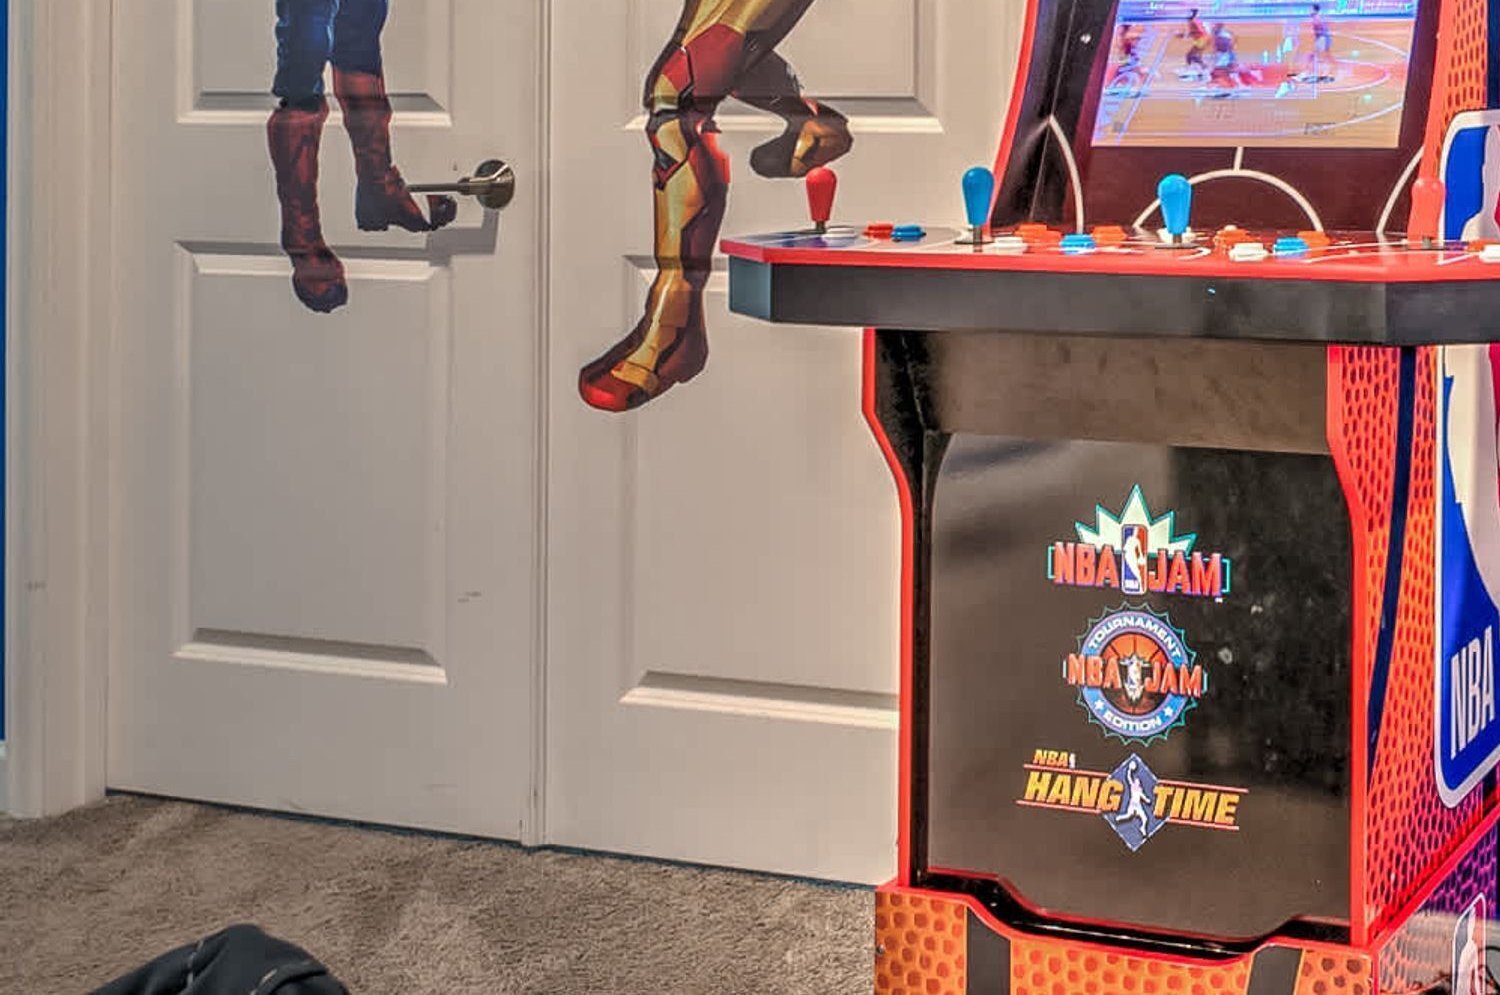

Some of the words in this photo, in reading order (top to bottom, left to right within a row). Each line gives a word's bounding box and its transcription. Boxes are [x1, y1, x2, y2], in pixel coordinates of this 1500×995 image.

[1052, 541, 1120, 589] NBA
[1148, 548, 1223, 597] JAM
[1087, 615, 1182, 659] TOURNAMENT
[1066, 653, 1121, 689] NBA
[1145, 660, 1203, 698] JAM
[1452, 625, 1495, 761] NBA
[1103, 712, 1162, 731] EDITION
[1032, 748, 1070, 768] NBA
[1024, 770, 1126, 812] HANG
[1153, 784, 1241, 825] TIME
